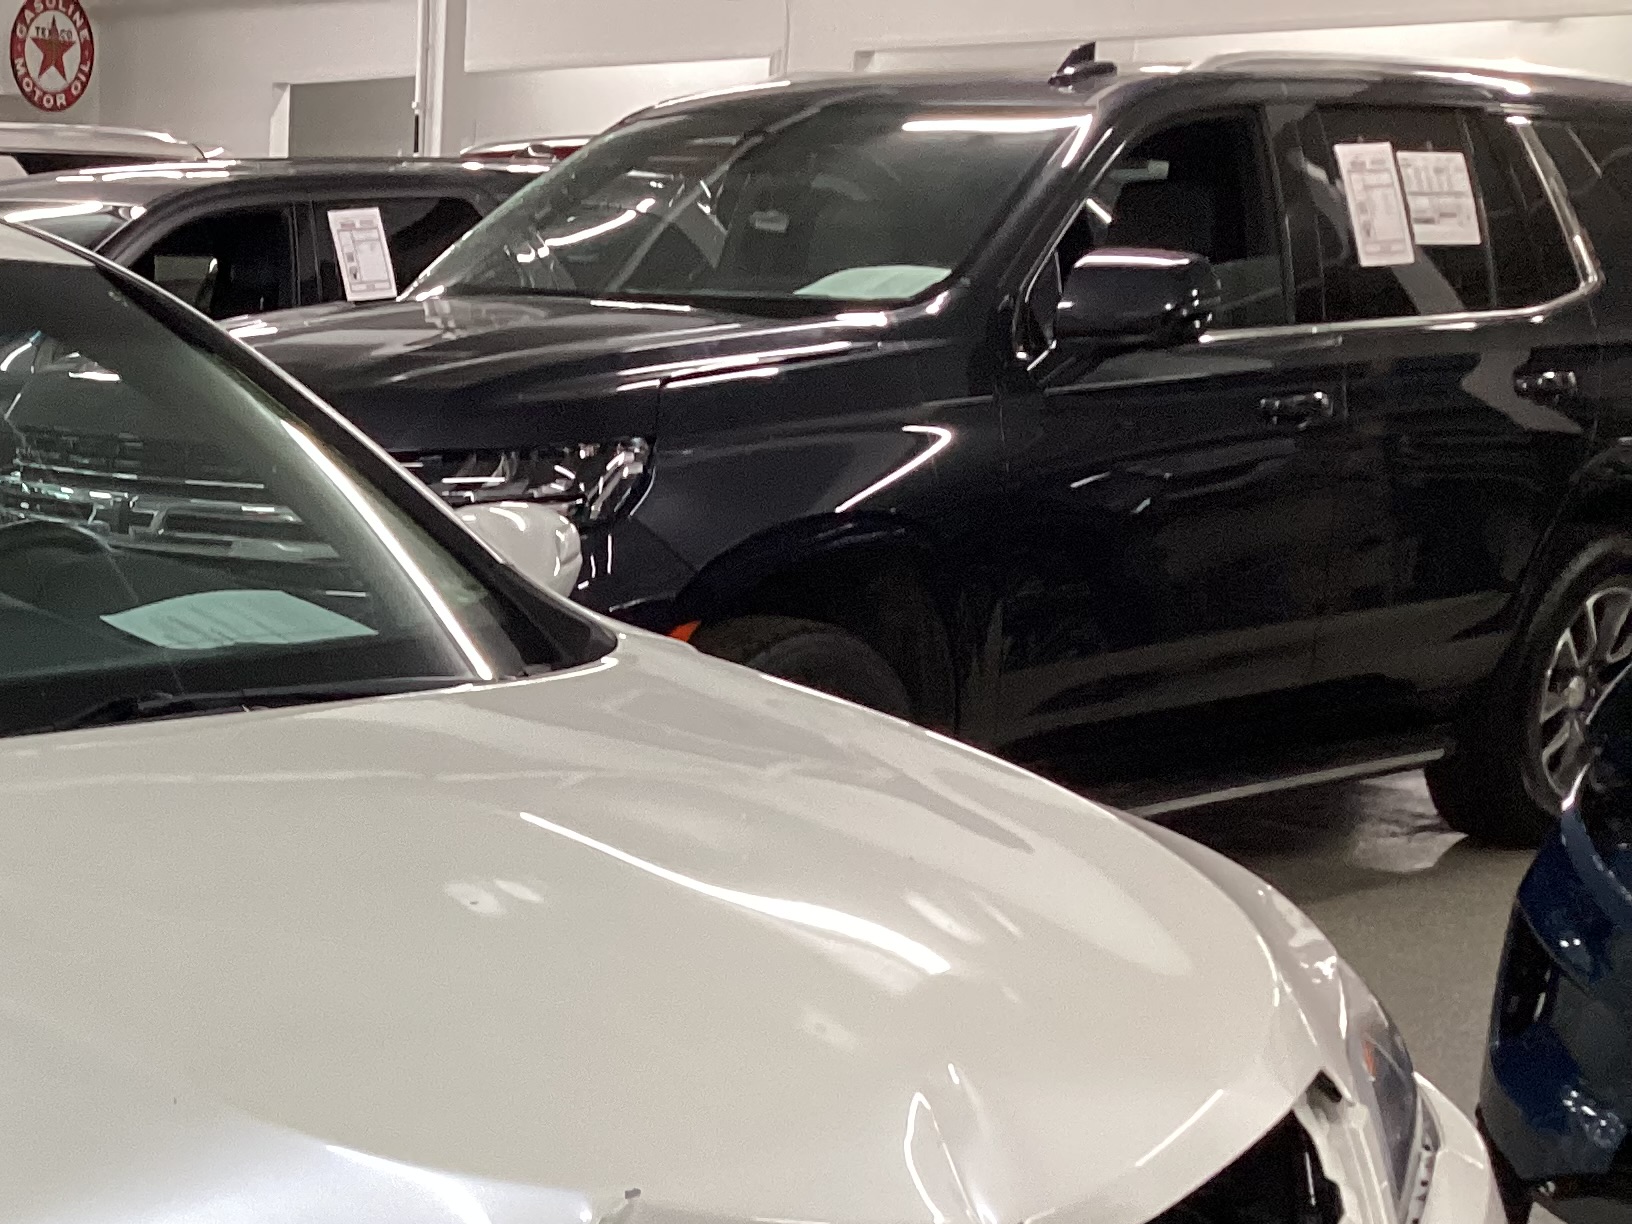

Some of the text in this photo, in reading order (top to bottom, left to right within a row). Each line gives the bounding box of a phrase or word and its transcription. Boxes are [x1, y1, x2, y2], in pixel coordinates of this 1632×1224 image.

[35, 26, 72, 40] TECO
[15, 58, 90, 109] MOTOR OIL
